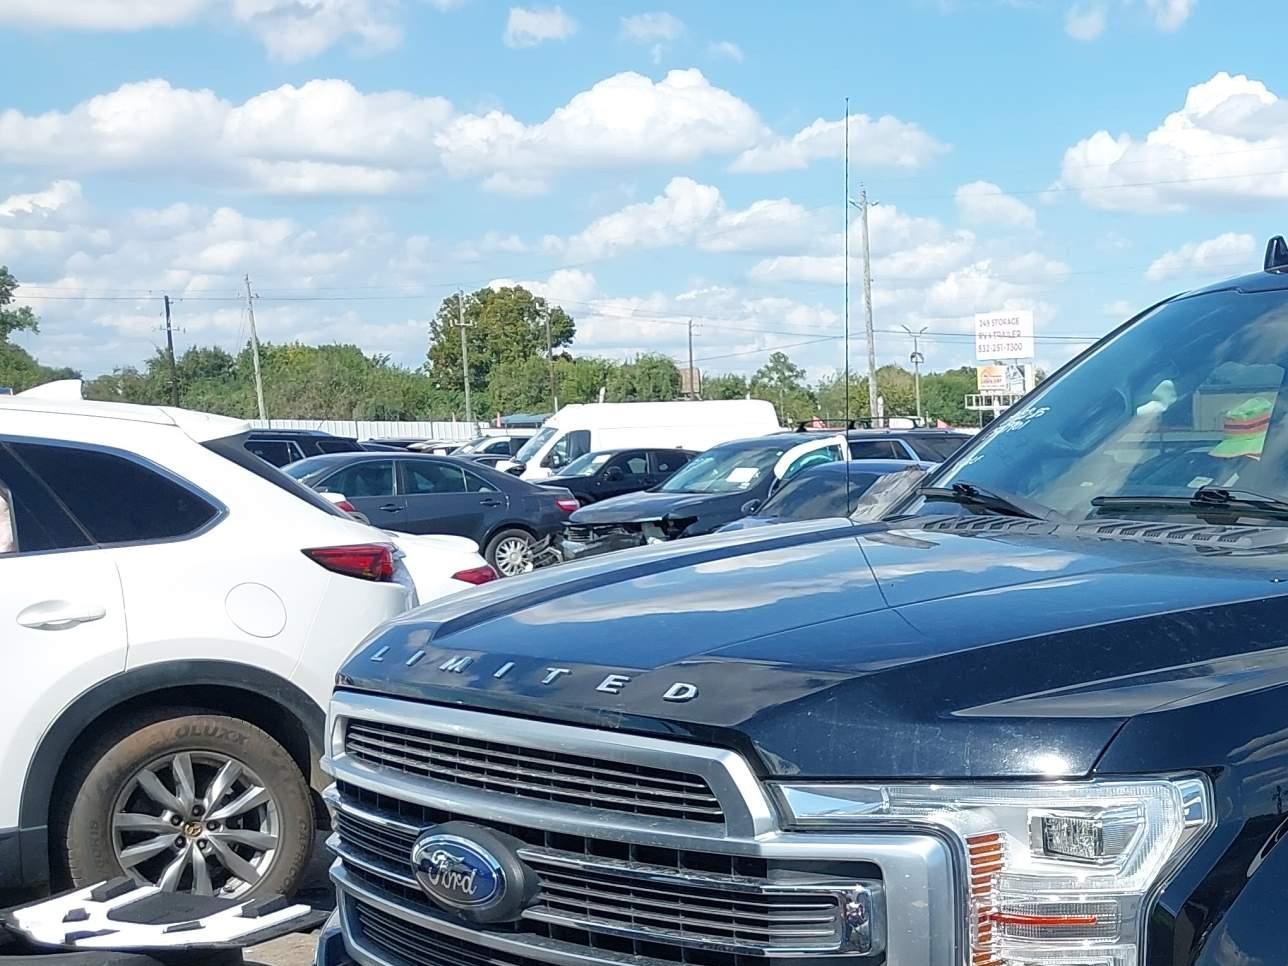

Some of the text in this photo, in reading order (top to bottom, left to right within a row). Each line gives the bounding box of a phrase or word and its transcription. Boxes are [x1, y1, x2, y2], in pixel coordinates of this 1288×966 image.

[991, 317, 1020, 327] STORAGE
[370, 645, 700, 702] LIMITED
[427, 848, 478, 895] Ford
